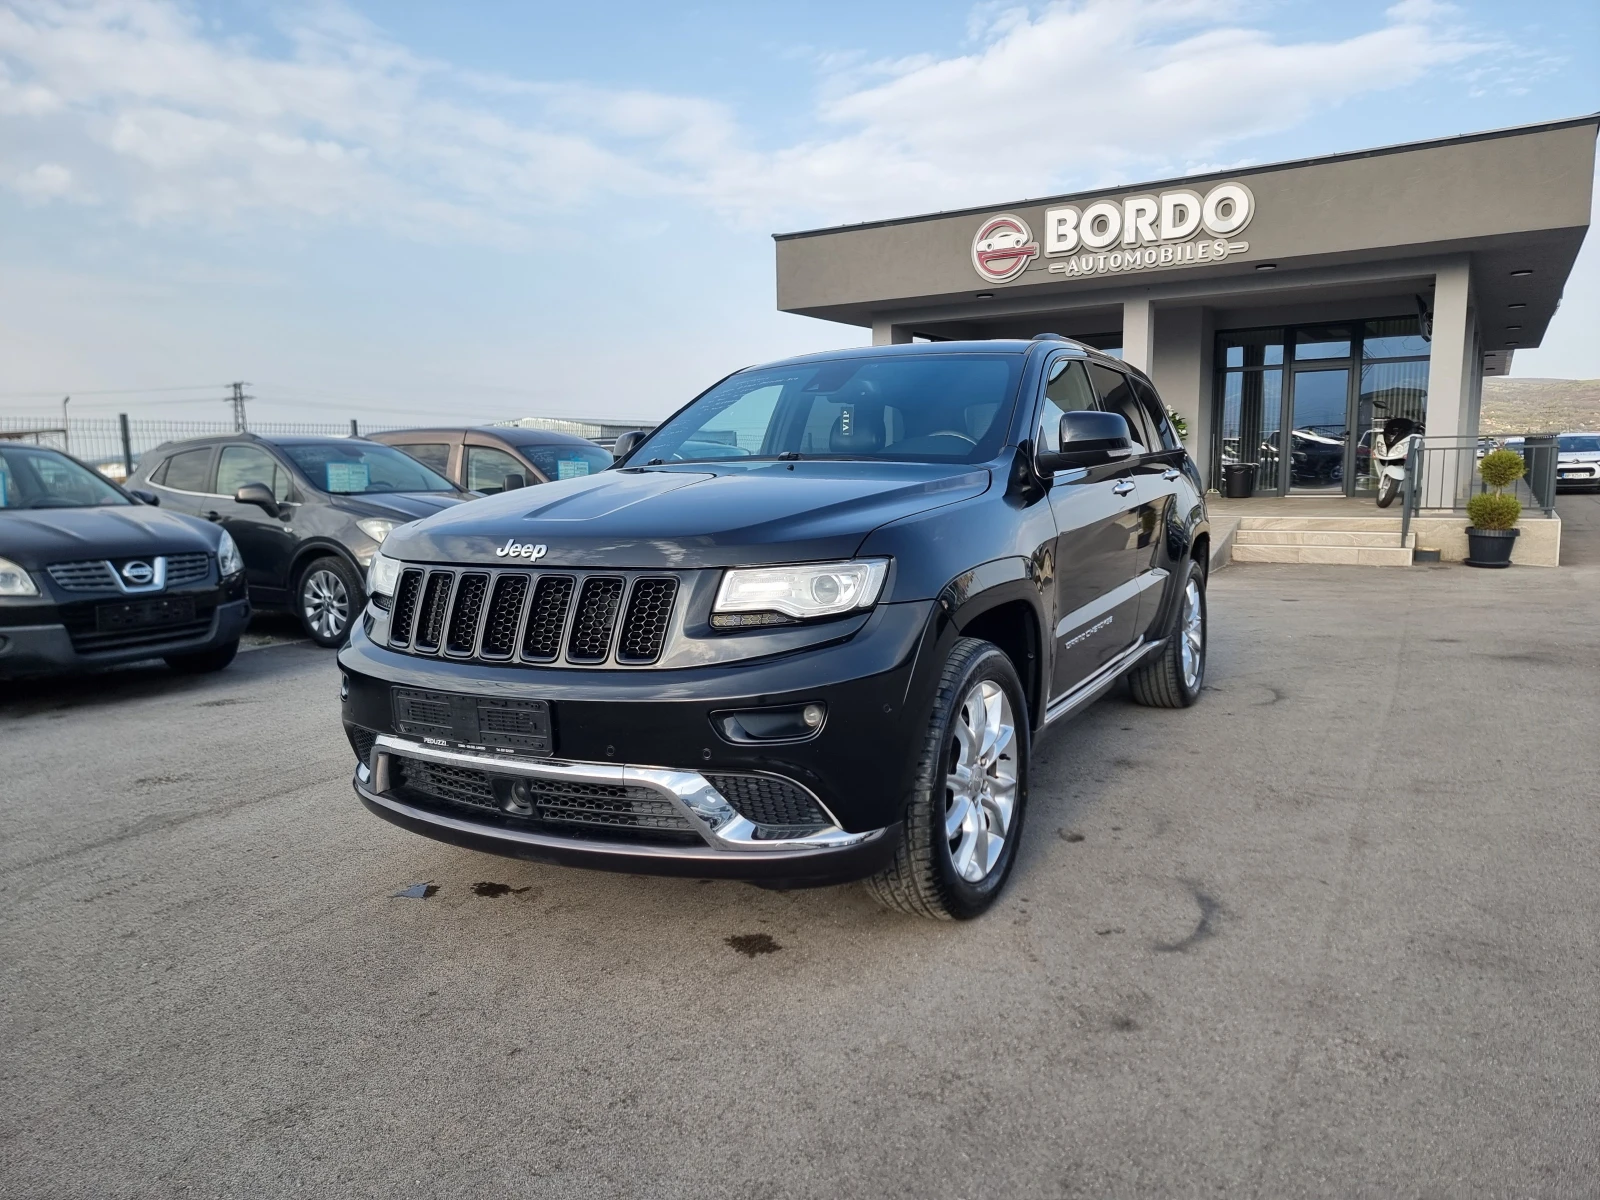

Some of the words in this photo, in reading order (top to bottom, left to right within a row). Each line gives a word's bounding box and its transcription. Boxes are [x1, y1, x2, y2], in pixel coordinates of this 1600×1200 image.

[1046, 184, 1252, 254] BORDO
[1066, 241, 1225, 275] AUTOMOBILES
[496, 538, 547, 562] Jeep
